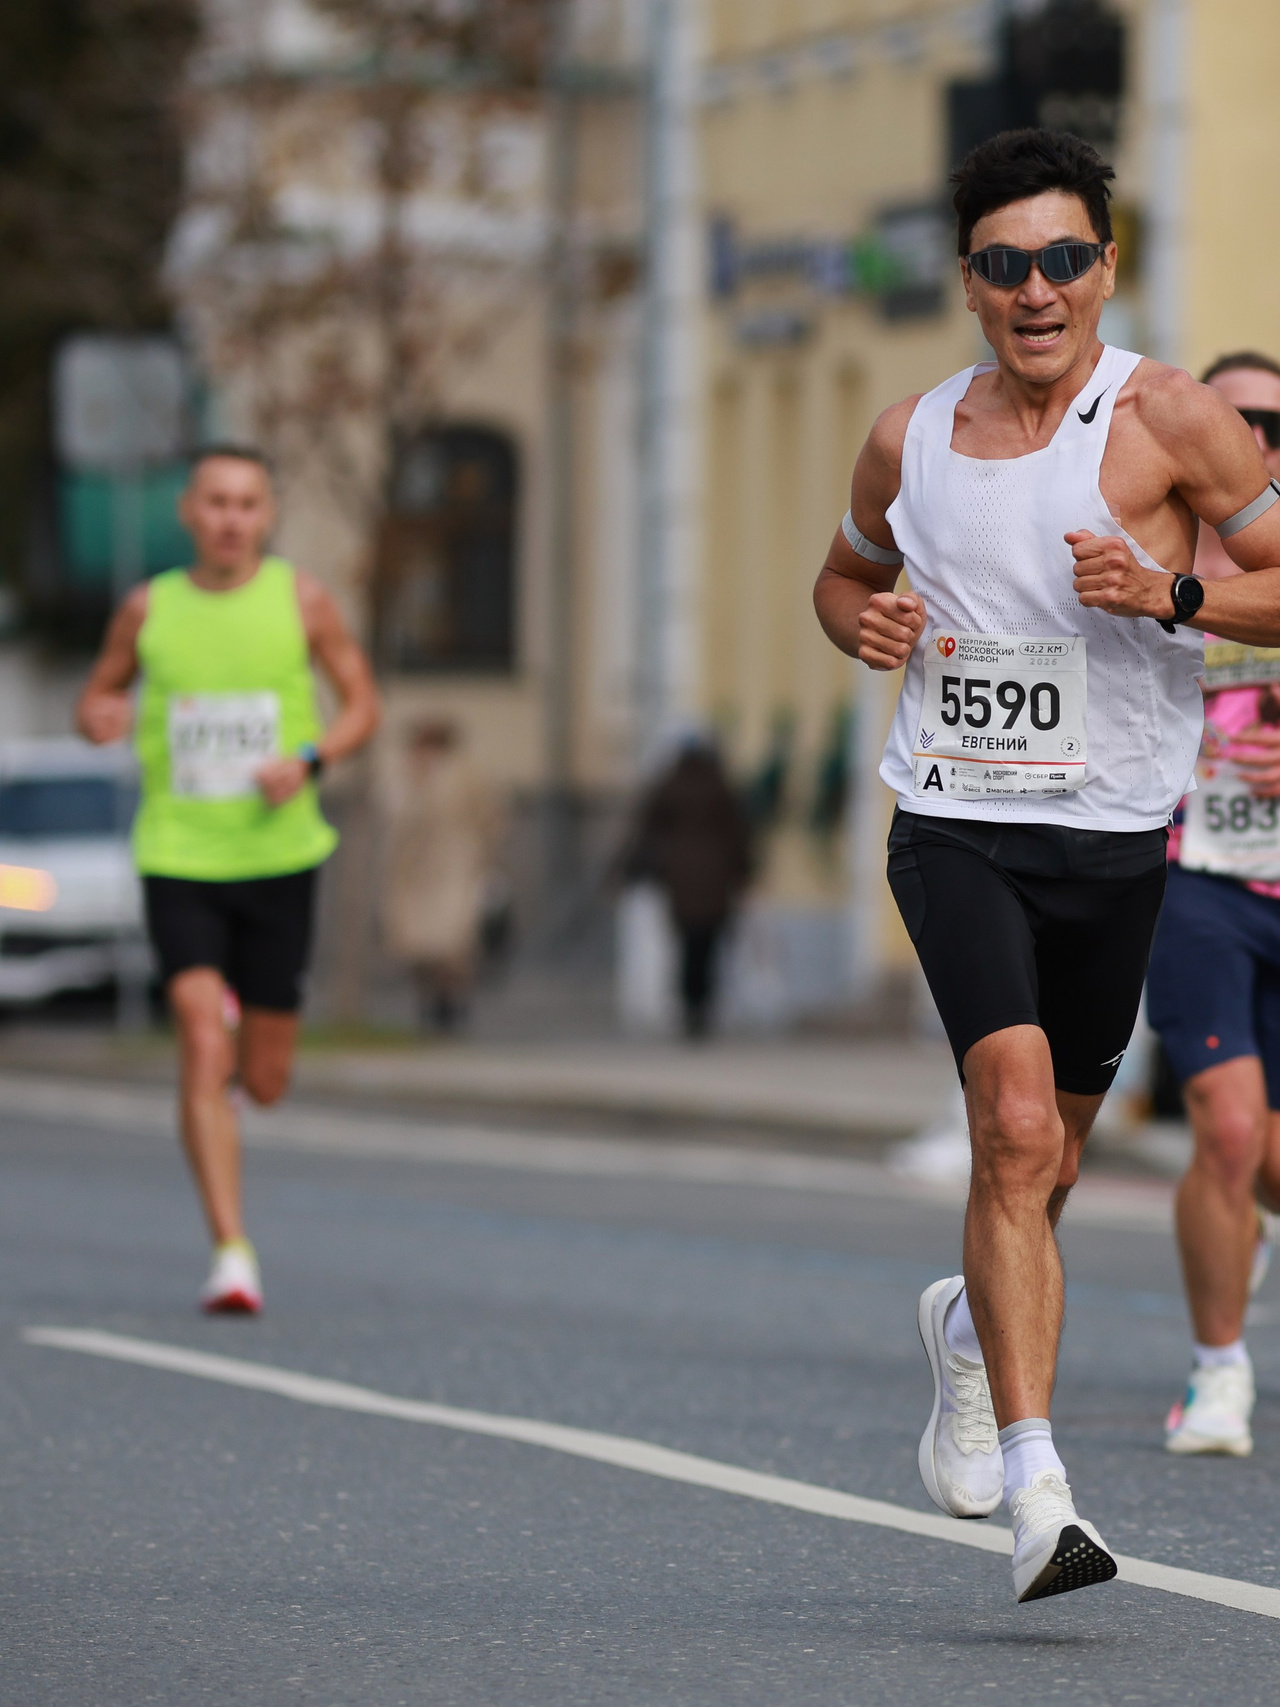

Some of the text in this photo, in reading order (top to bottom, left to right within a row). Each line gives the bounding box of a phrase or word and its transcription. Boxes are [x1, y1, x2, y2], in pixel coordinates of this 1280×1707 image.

[958, 638, 999, 647] СБЕРПРАЙМ
[958, 645, 1015, 656] МОСКОВСКИЙ
[1024, 645, 1044, 654] 42,2
[958, 653, 999, 664] МАРАФОН
[940, 675, 1061, 731] 5590
[961, 735, 1028, 751] ЕВГЕНИЙ
[1067, 742, 1075, 751] 2
